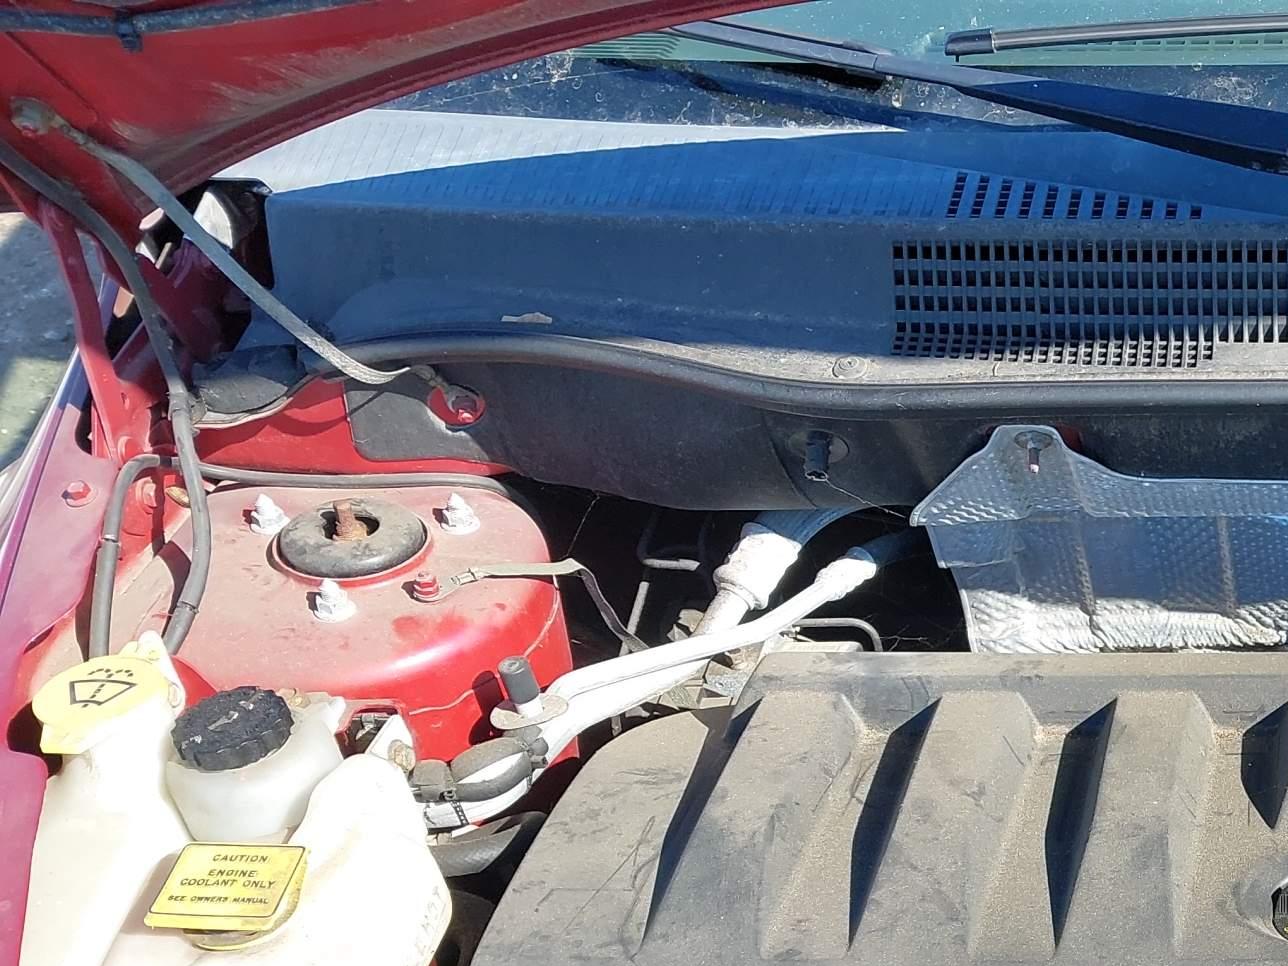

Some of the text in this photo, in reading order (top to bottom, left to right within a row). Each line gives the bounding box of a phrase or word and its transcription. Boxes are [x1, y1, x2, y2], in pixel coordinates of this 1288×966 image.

[212, 854, 269, 863] CAUTION
[207, 868, 258, 878] ENGINE
[180, 878, 276, 889] COOLANT ONLY
[232, 897, 269, 905] MANUAL
